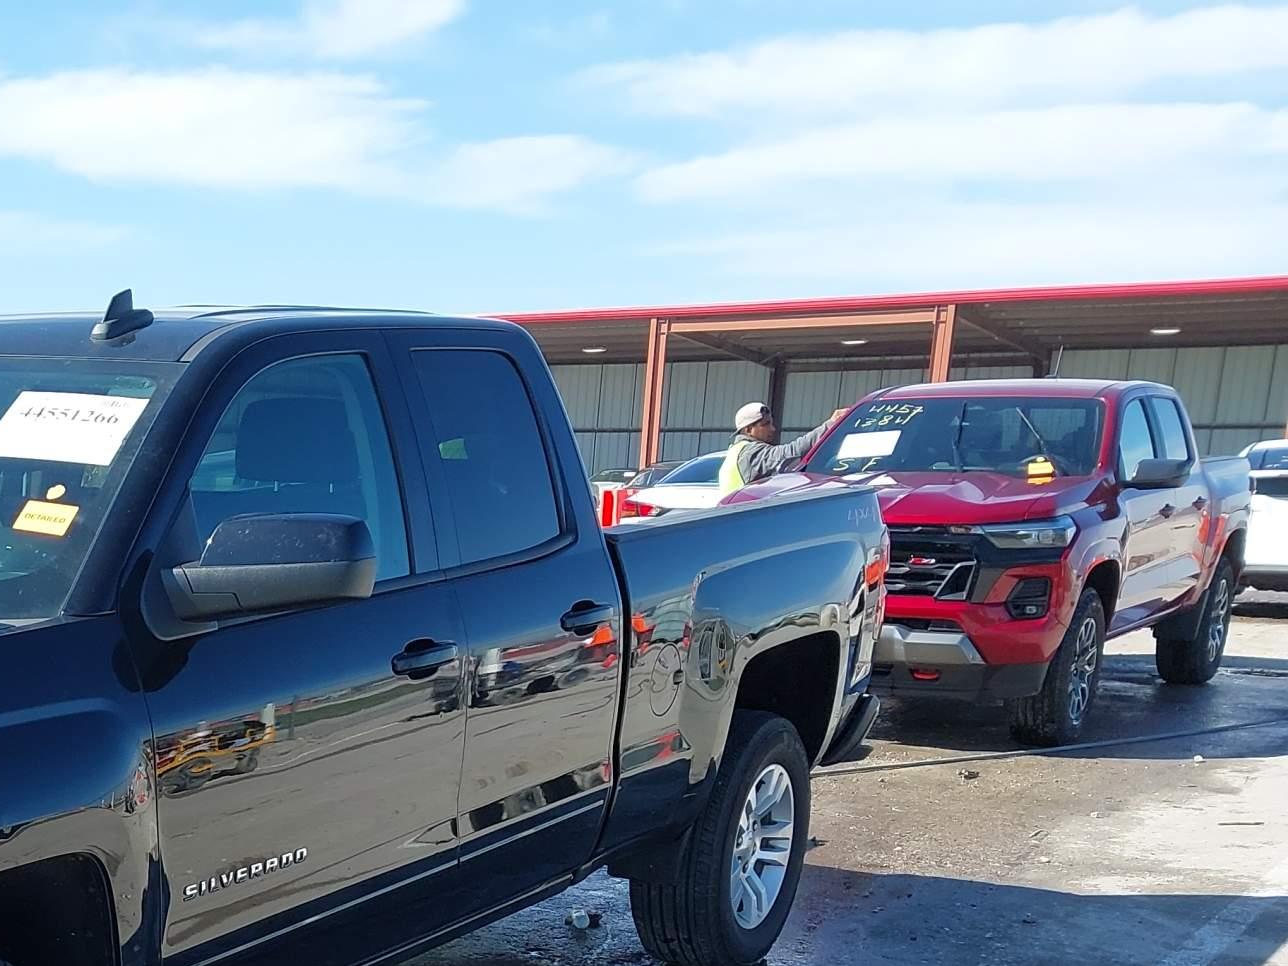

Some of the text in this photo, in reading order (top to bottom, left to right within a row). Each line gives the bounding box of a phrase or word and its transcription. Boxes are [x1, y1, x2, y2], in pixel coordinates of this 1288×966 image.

[20, 406, 120, 425] 44551266
[869, 404, 924, 418] 4457
[854, 414, 911, 428] 1384
[861, 457, 883, 472] F
[183, 847, 308, 902] SILVERADO
